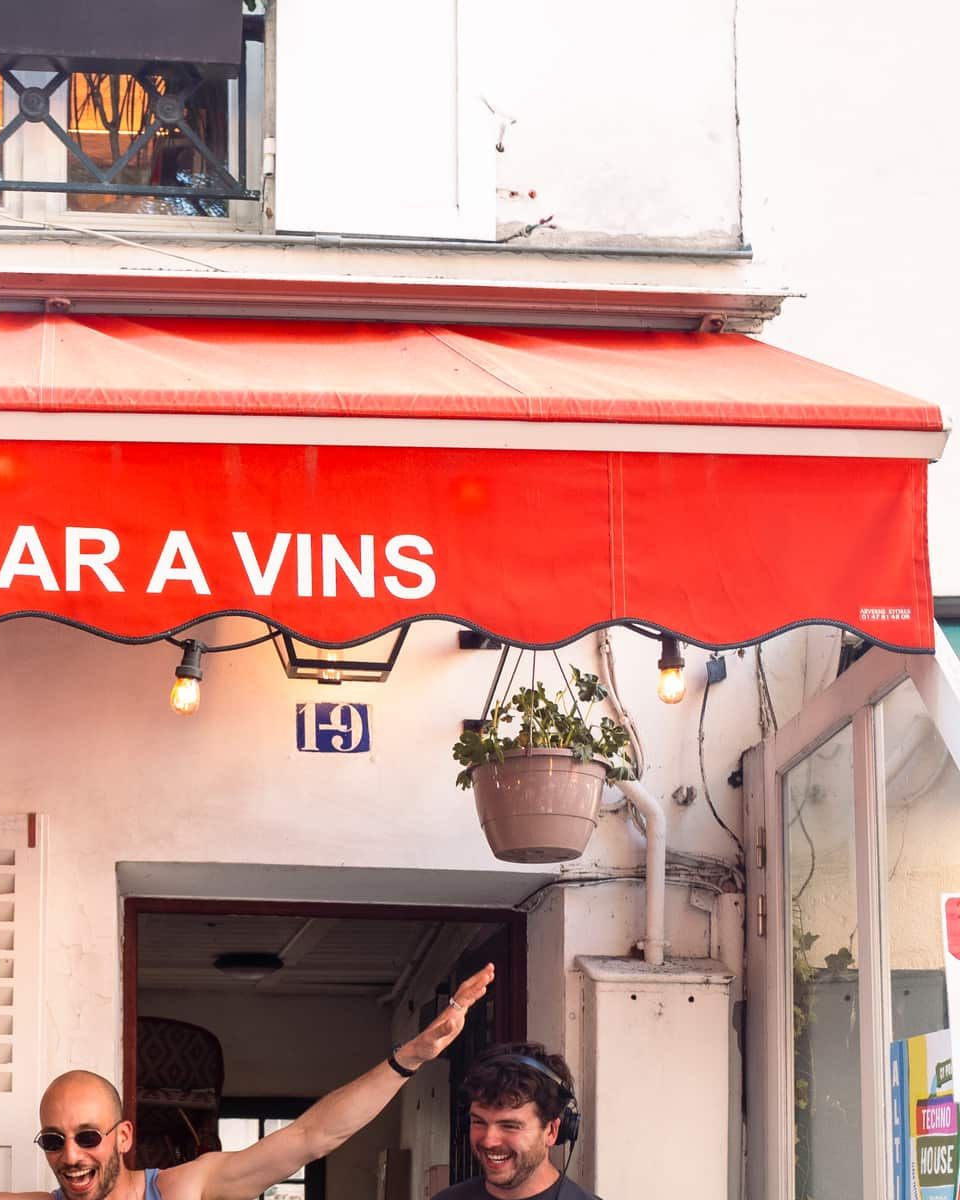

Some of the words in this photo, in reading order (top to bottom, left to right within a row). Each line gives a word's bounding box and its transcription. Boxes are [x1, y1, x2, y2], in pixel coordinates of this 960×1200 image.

[146, 530, 211, 595] A
[232, 531, 437, 599] VINS
[299, 702, 364, 752] 19
[921, 1105, 951, 1130] TECHNO
[920, 1144, 954, 1175] HOUSE
